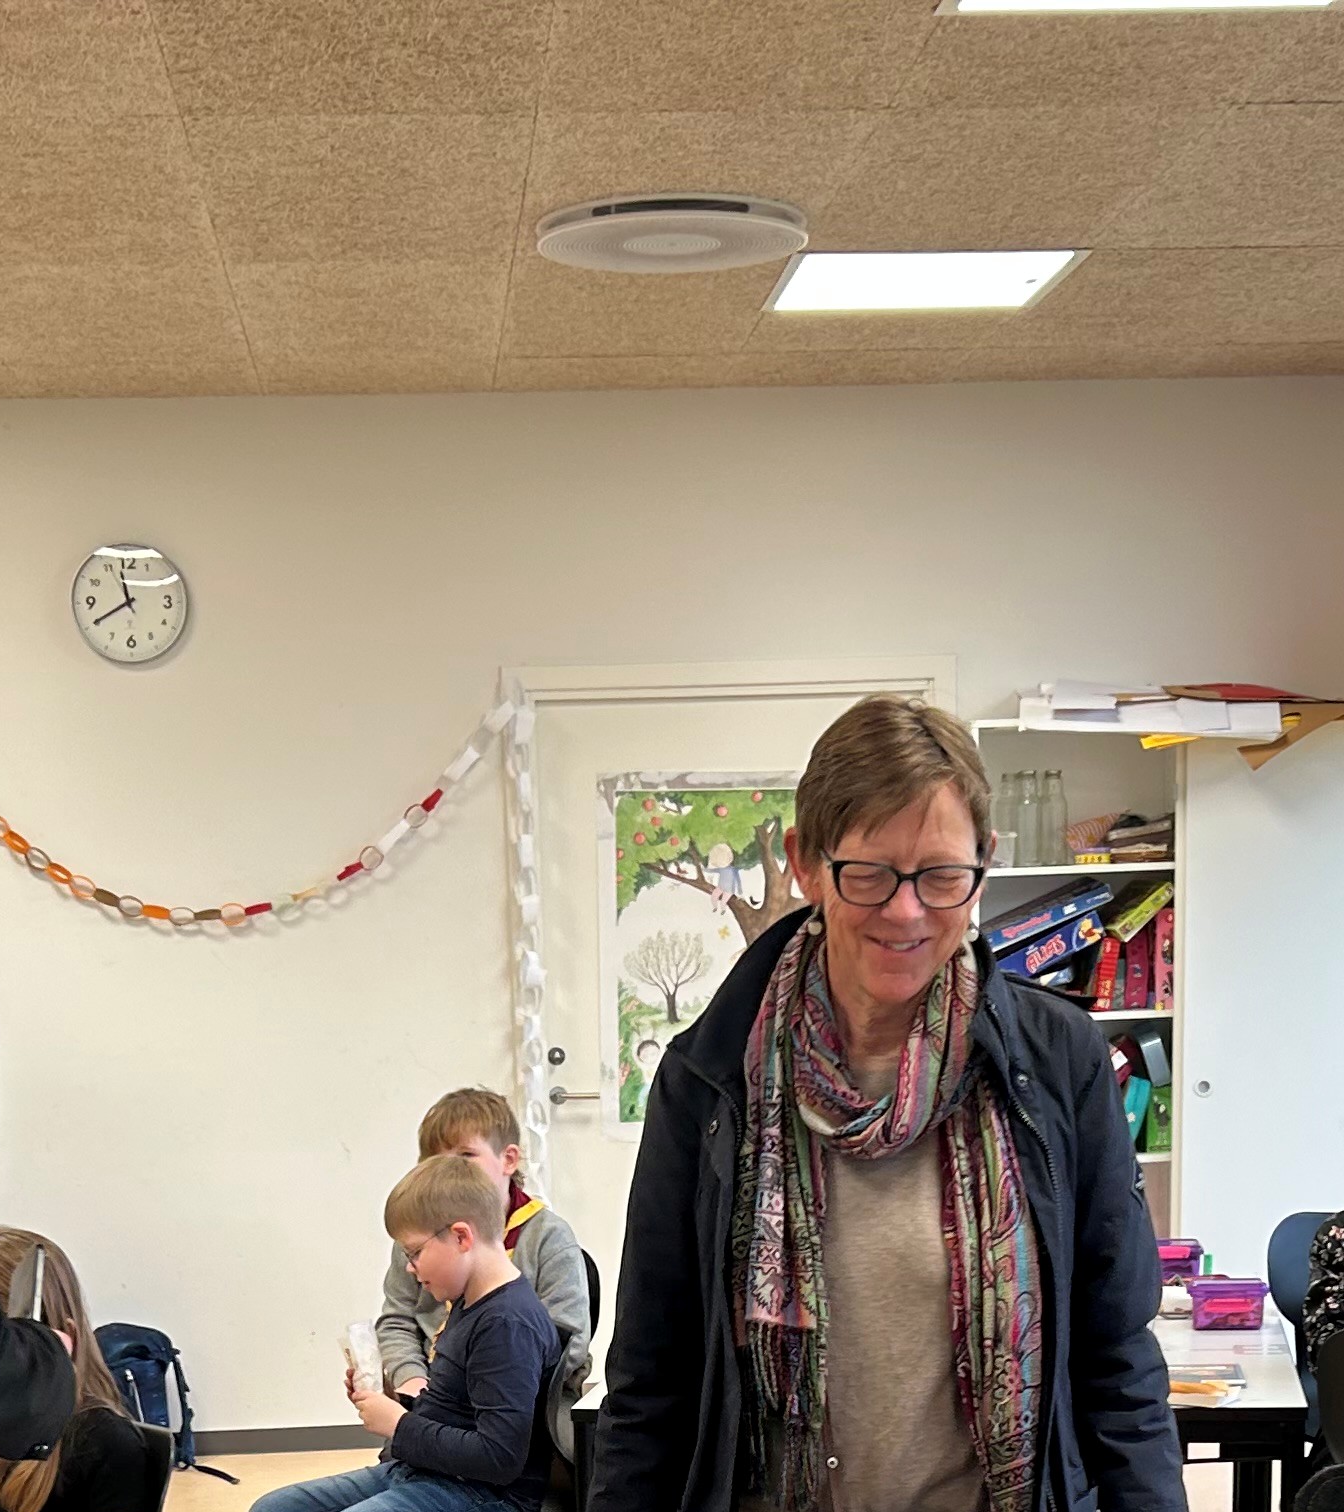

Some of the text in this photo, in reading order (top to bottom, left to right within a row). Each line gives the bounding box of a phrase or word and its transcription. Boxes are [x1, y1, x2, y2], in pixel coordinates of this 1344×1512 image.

[119, 557, 137, 570] 12
[144, 563, 150, 572] 1
[85, 595, 97, 610] 9
[162, 594, 173, 609] 3
[160, 618, 168, 626] 4
[126, 634, 137, 649] 6
